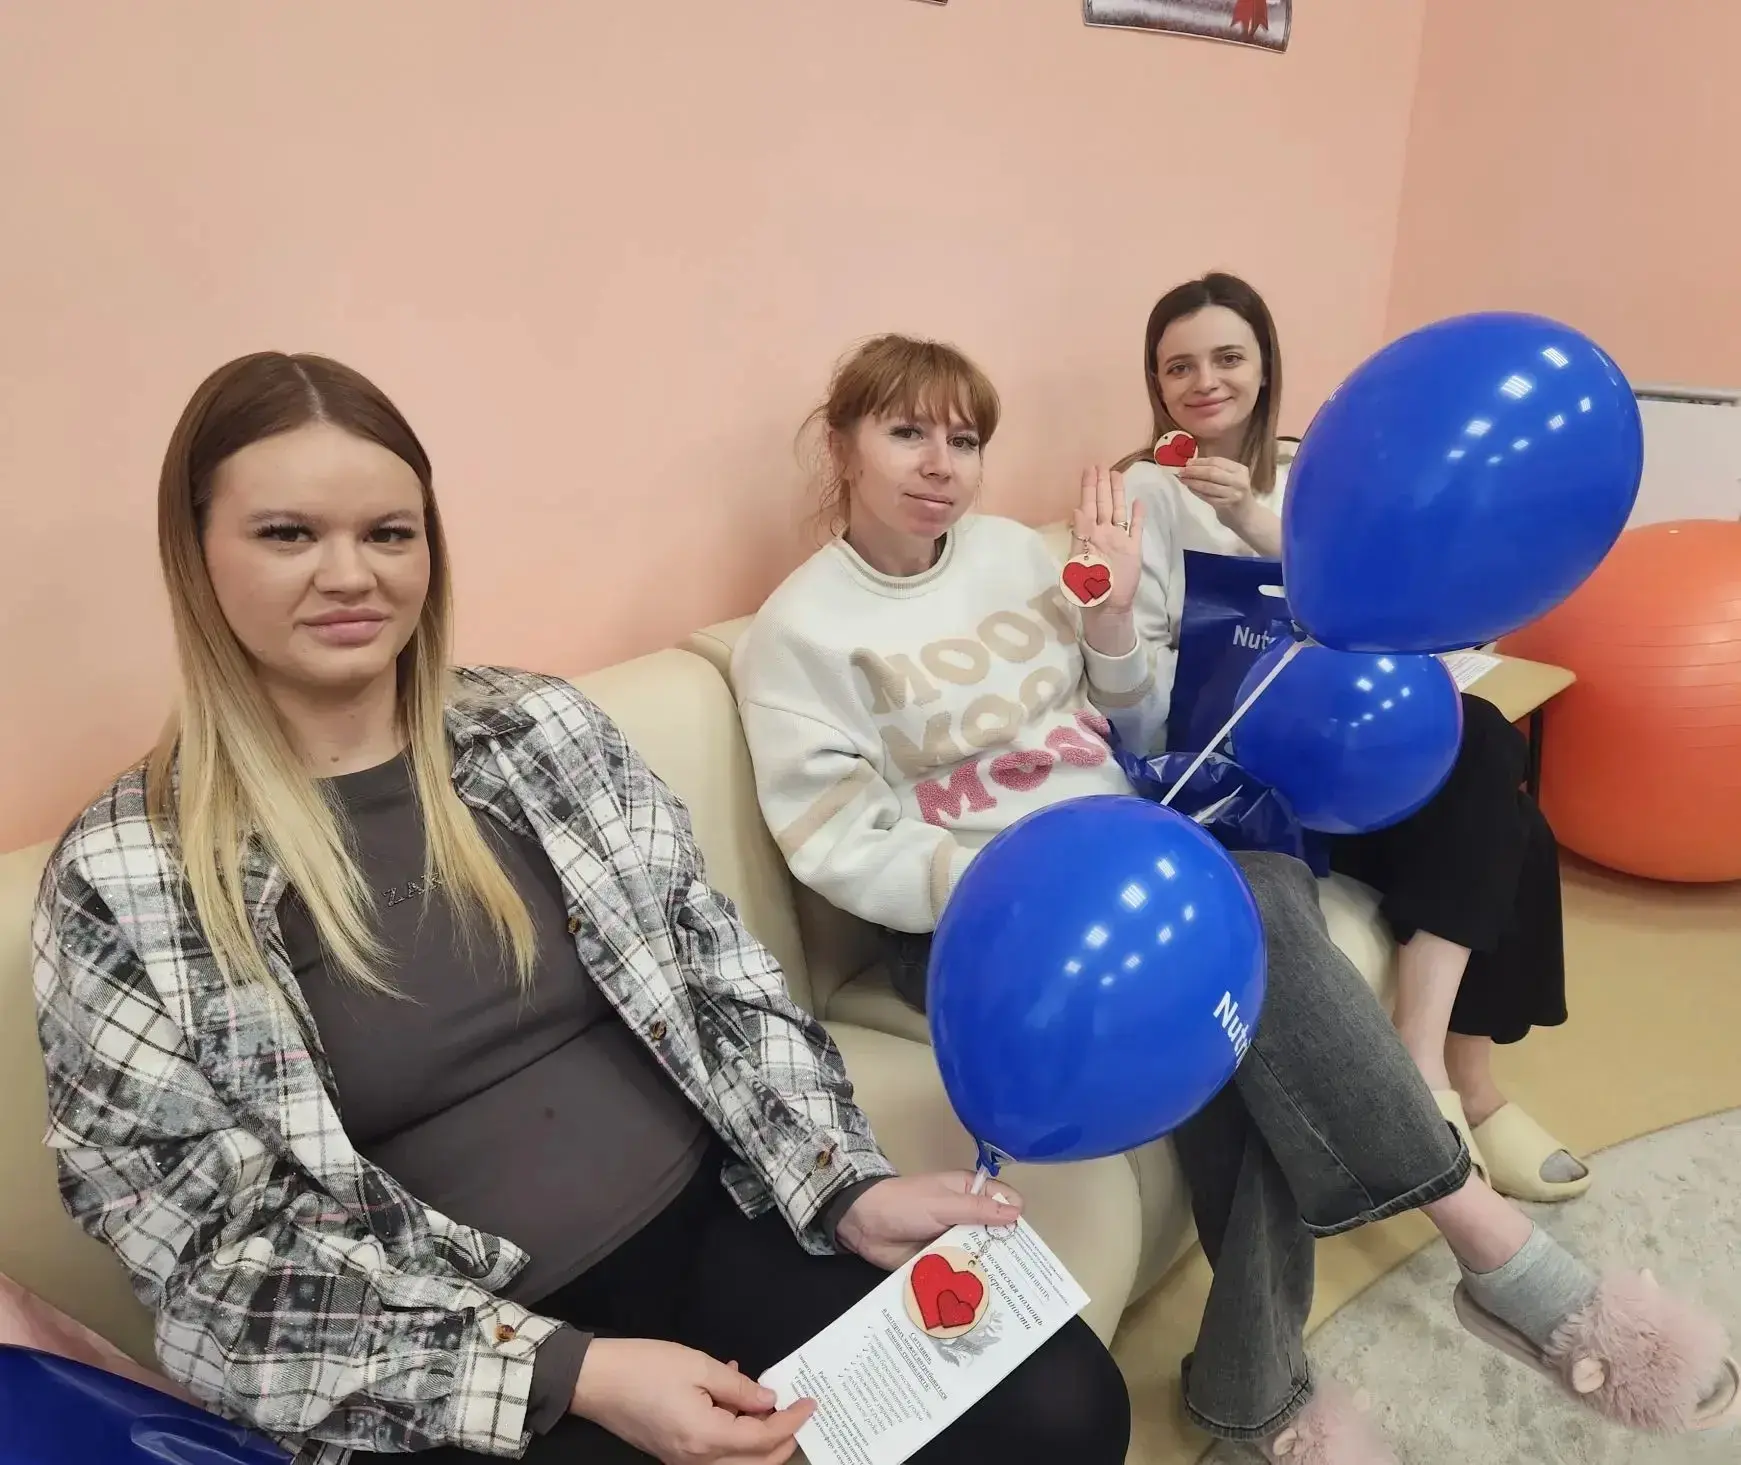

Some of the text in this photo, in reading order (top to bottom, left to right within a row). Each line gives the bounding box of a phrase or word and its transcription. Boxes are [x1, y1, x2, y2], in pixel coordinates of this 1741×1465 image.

[1213, 991, 1251, 1072] Nutri
[985, 1271, 1032, 1331] беременности
[1016, 1292, 1044, 1327] помощь
[850, 1434, 873, 1465] беременно
